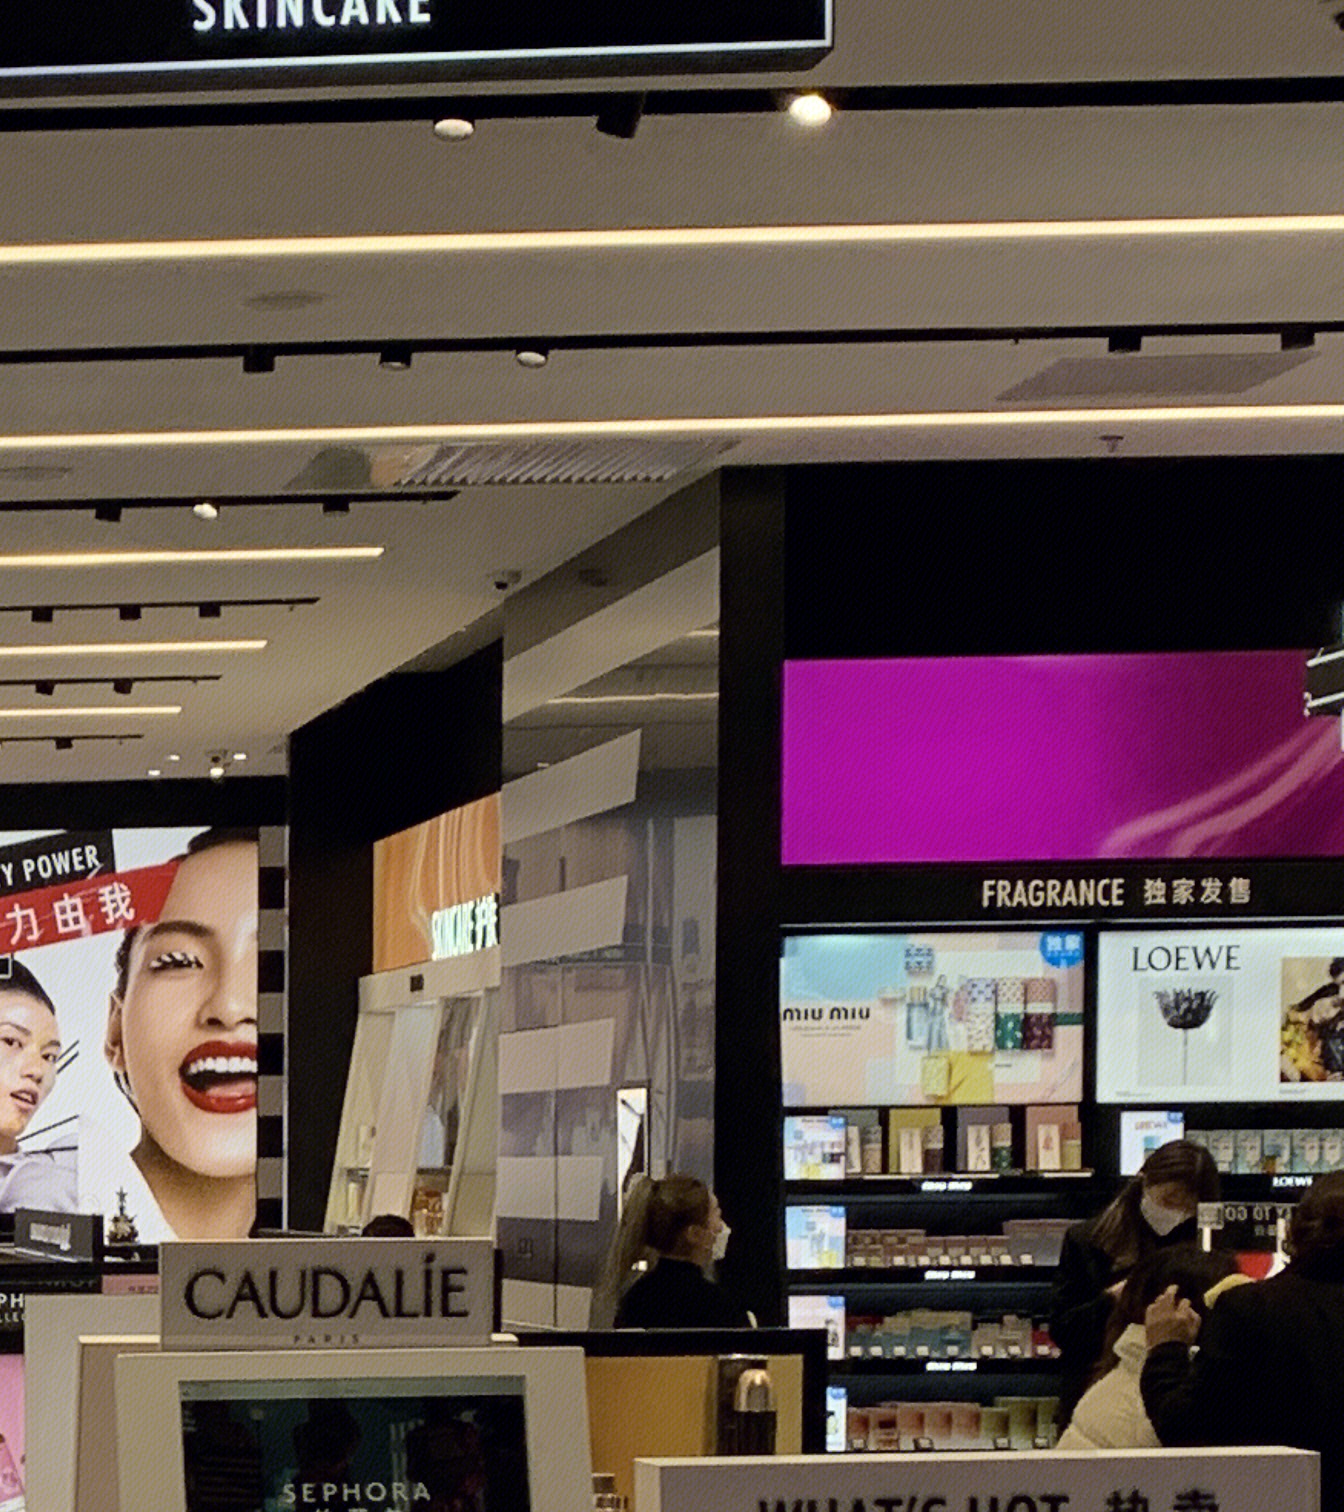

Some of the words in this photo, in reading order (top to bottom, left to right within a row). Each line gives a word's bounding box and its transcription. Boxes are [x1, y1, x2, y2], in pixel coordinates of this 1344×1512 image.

[23, 844, 101, 882] POWER
[981, 878, 1126, 909] FRAGRANCE
[1143, 877, 1252, 905] 独家发售
[1132, 944, 1242, 972] LOEWE
[782, 1006, 823, 1022] miu
[829, 1005, 871, 1022] miu
[293, 1333, 361, 1345] PARIS
[282, 1482, 432, 1503] SEPHORA
